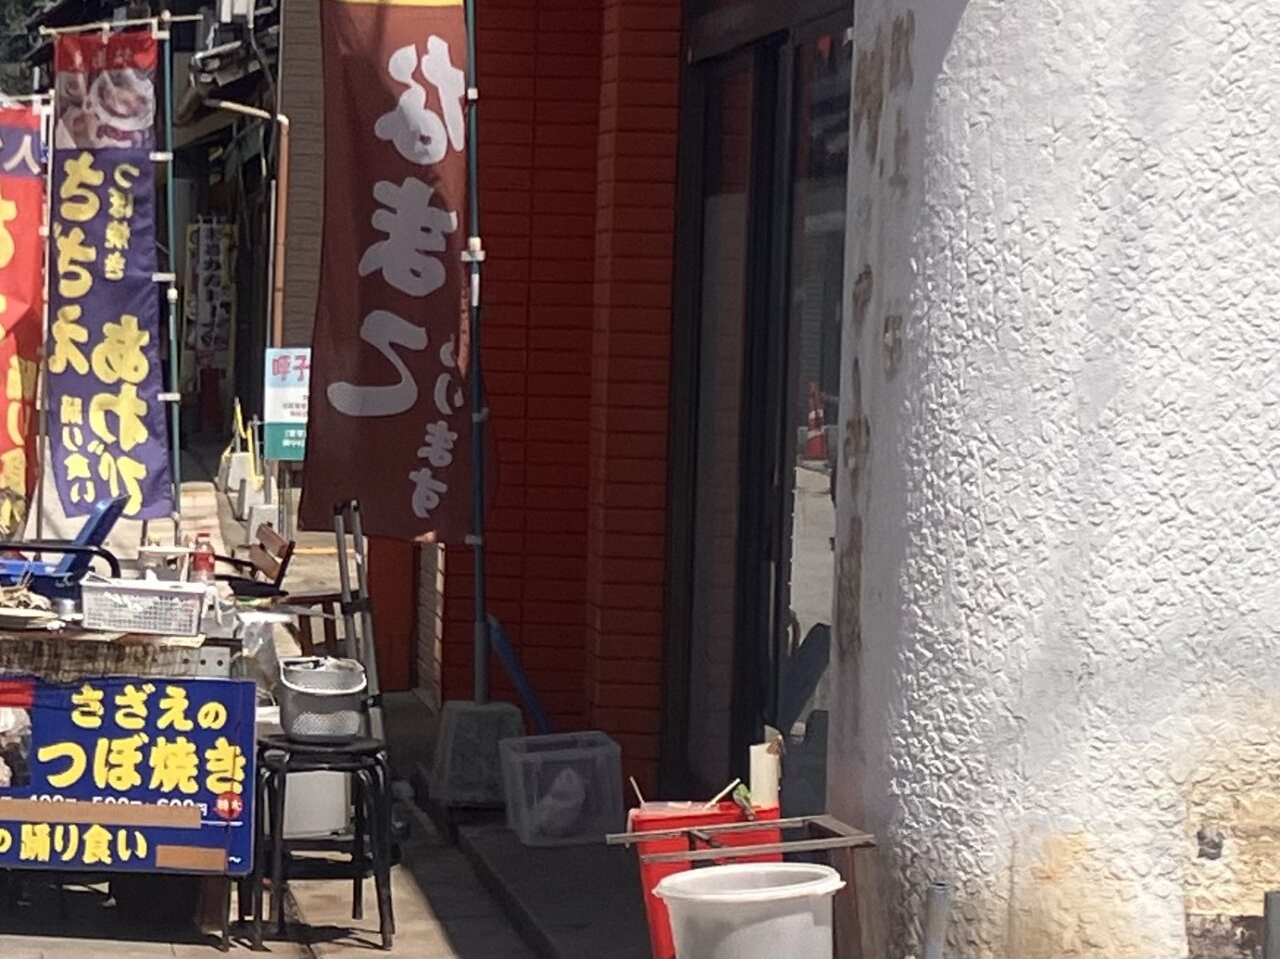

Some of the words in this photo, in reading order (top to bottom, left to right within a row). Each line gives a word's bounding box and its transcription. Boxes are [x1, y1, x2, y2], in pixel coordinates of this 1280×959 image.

[71, 682, 228, 731] さざえの
[37, 732, 246, 795] つぼ焼き
